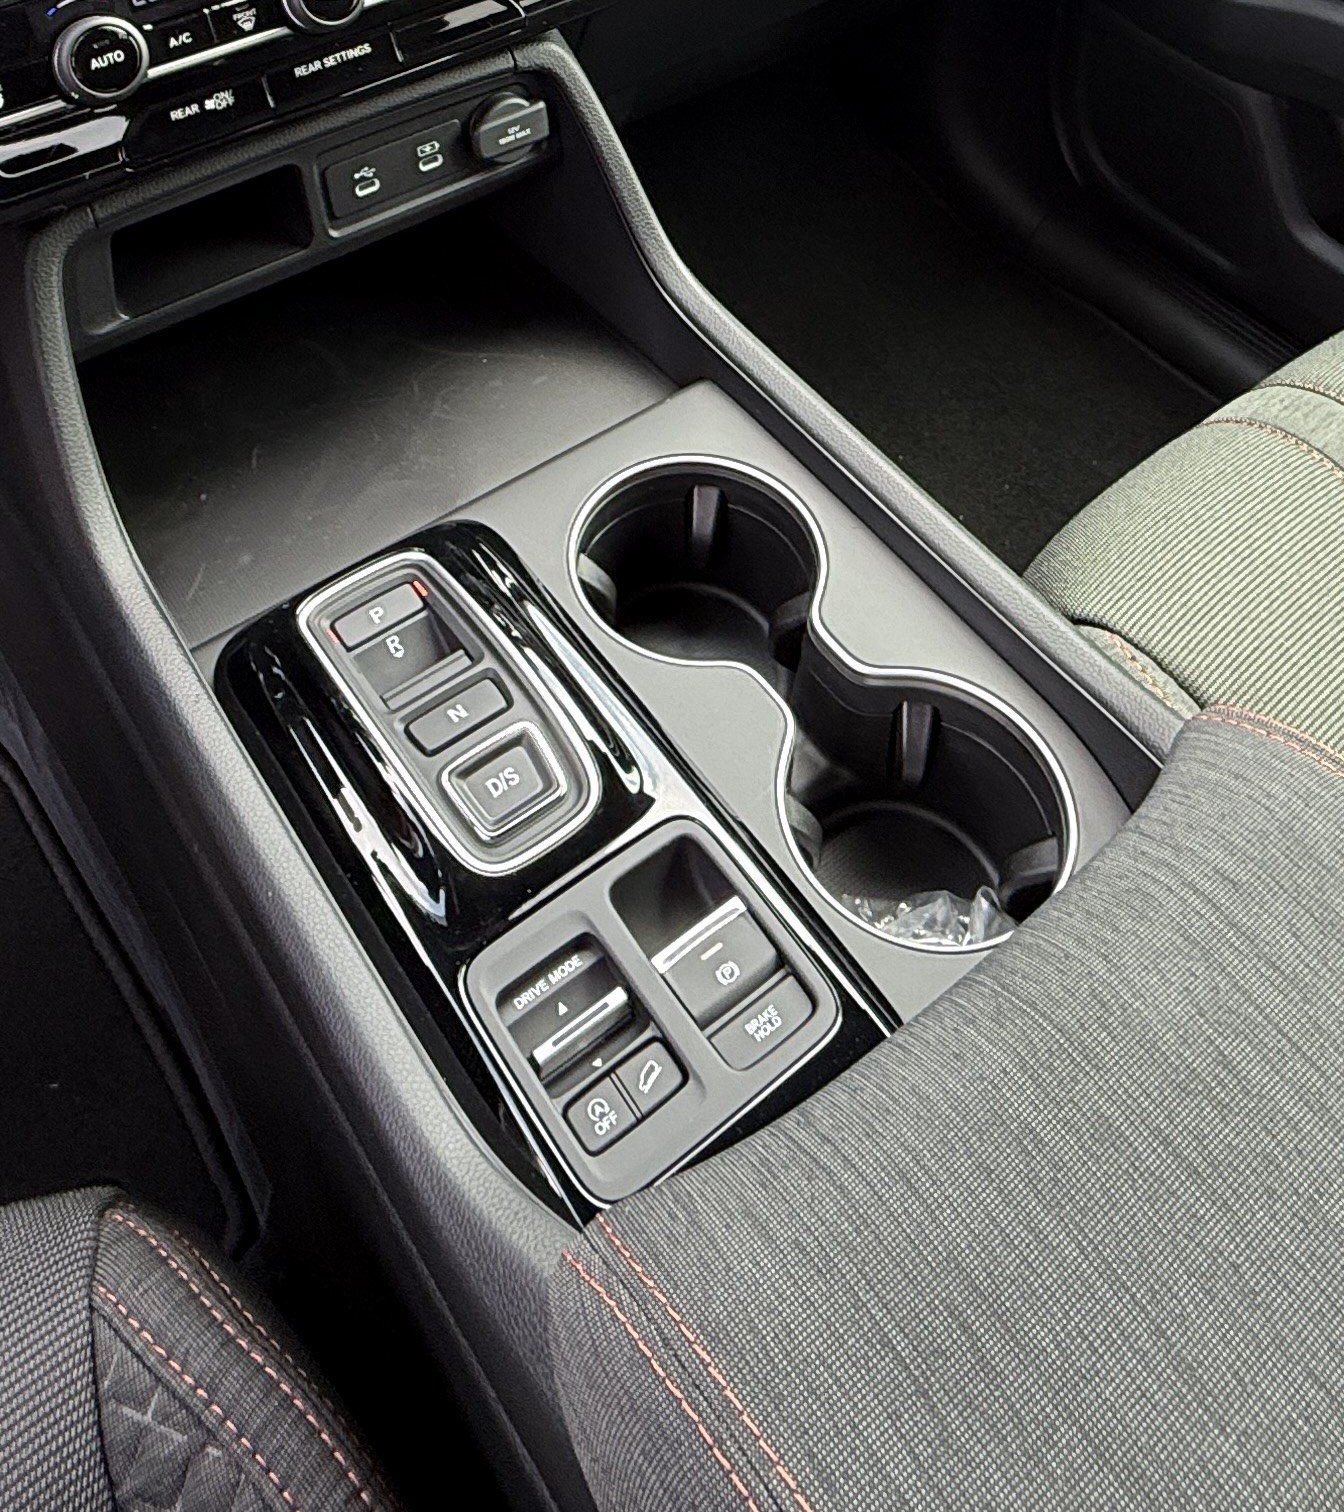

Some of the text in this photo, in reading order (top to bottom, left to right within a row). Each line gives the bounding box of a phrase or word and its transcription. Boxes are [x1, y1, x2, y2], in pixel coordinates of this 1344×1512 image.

[169, 32, 193, 49] A/C
[90, 49, 126, 71] AUTO
[293, 43, 373, 78] REAR SETTINGS
[169, 103, 201, 122] REAR
[368, 606, 384, 625] P
[446, 703, 469, 723] N
[484, 766, 521, 799] D/S
[513, 954, 584, 1010] DRIVE MODE
[744, 1004, 779, 1036] BRAKE
[753, 1015, 783, 1043] HOLD
[594, 1110, 619, 1136] OFF
